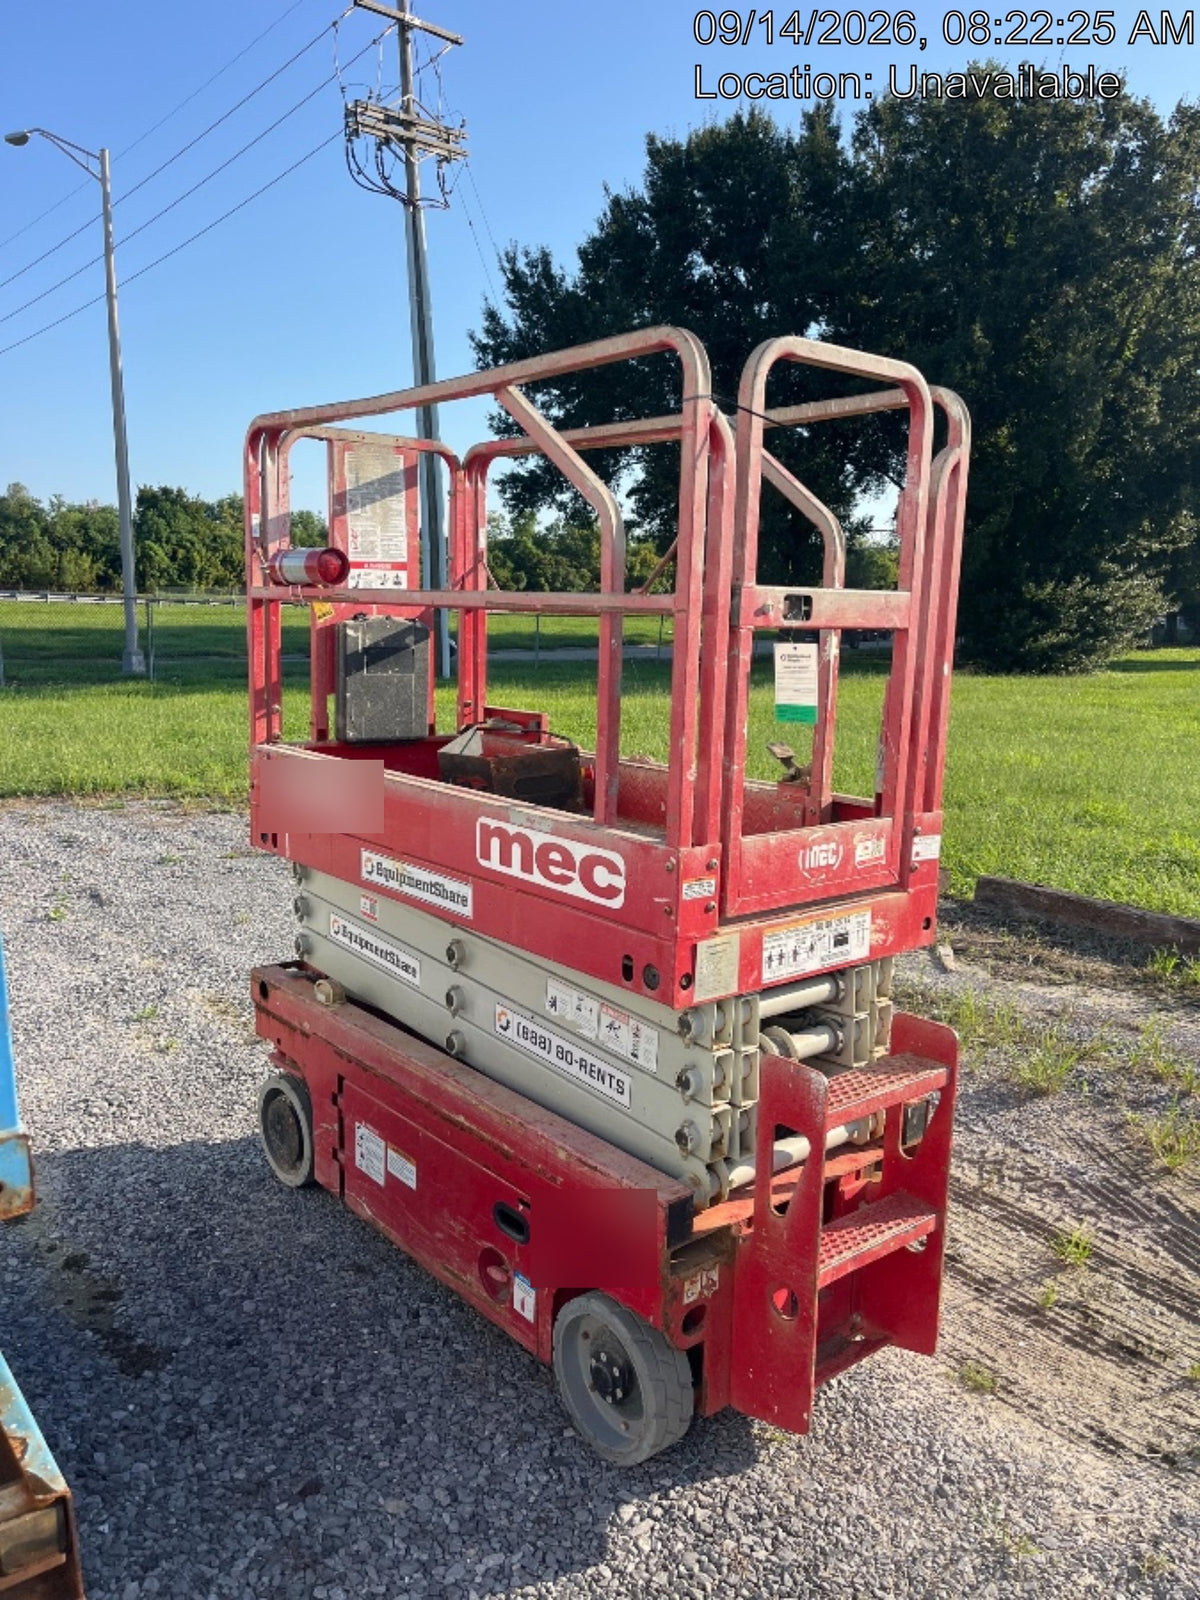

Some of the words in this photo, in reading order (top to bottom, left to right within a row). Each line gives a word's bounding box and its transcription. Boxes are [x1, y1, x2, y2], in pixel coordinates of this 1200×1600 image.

[376, 861, 469, 908] EquipmentShare
[479, 822, 623, 900] mec
[341, 923, 418, 978] EquipmentShare
[516, 1020, 552, 1055] (888)
[555, 1044, 625, 1096] 80-RENTS
